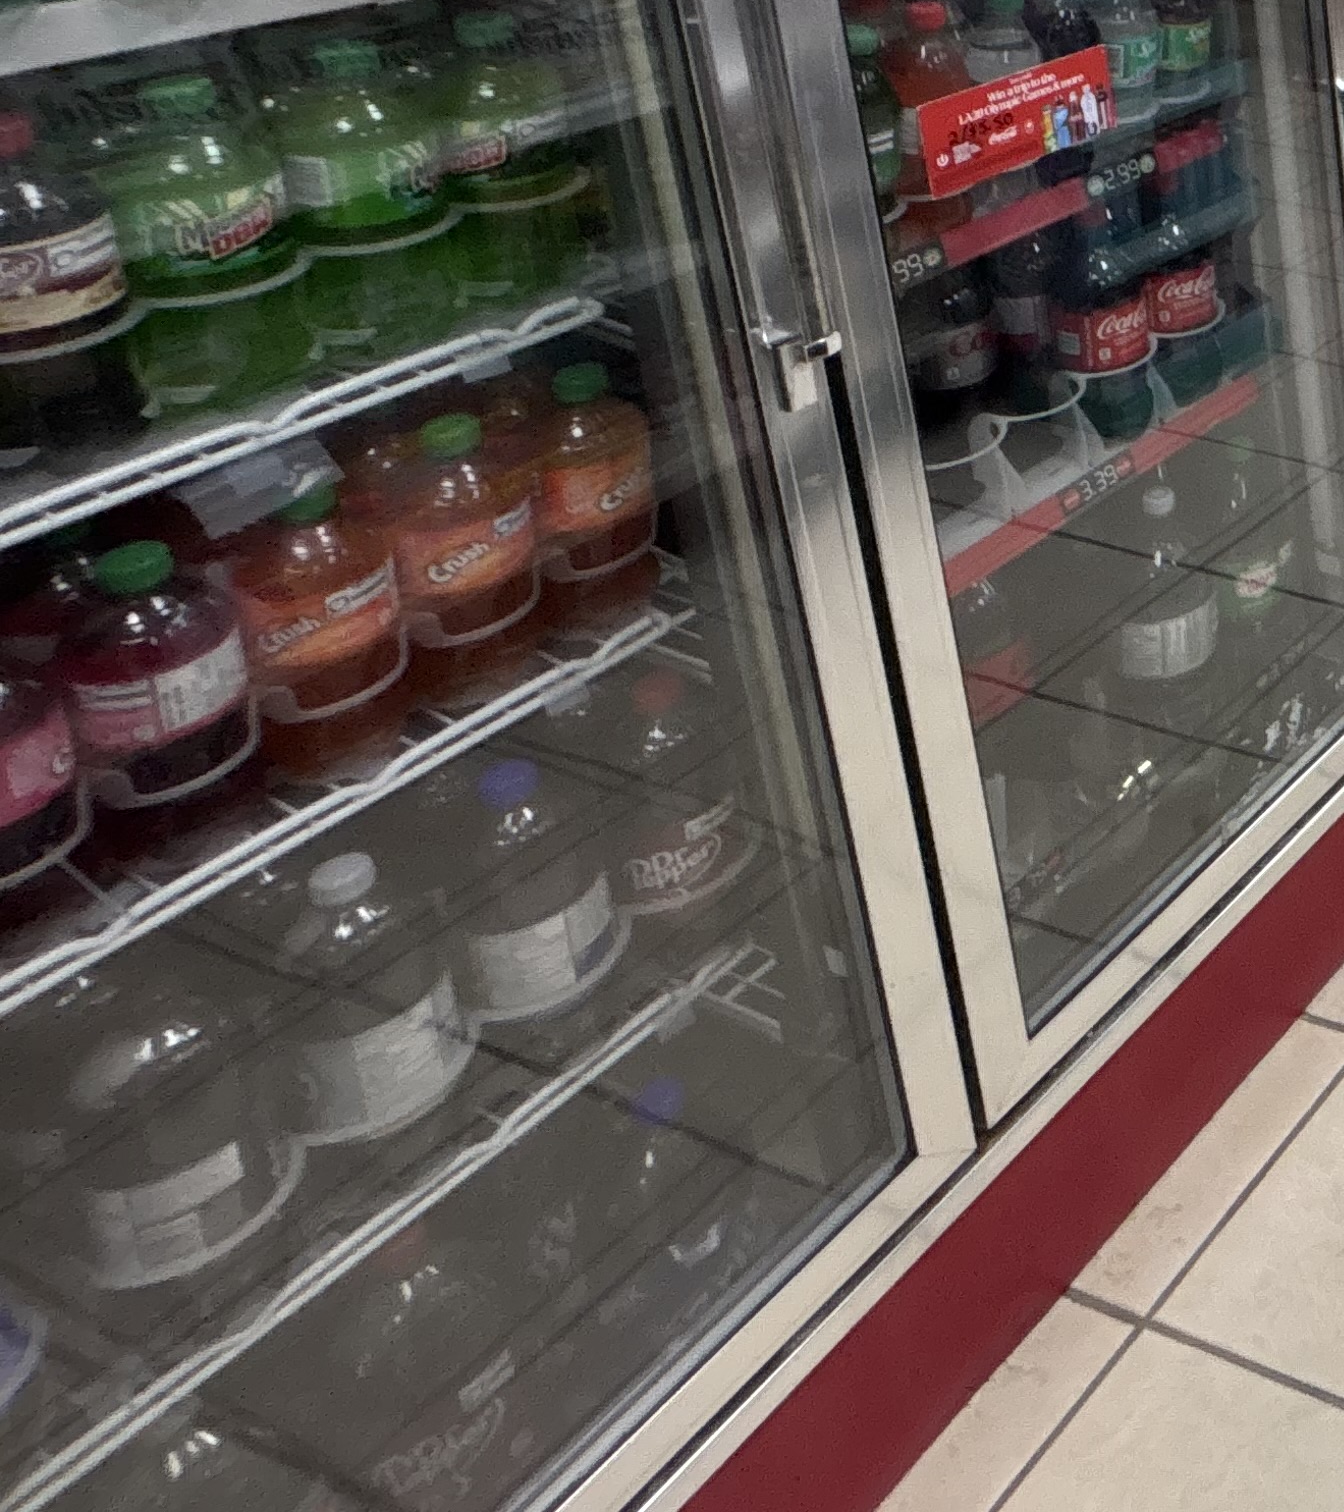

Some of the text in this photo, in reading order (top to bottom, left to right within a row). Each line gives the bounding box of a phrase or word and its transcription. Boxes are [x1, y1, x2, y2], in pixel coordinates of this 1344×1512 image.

[1103, 158, 1142, 191] 2.99
[1079, 463, 1118, 501] 3.39
[428, 540, 490, 584] Crush
[257, 616, 322, 655] Crush
